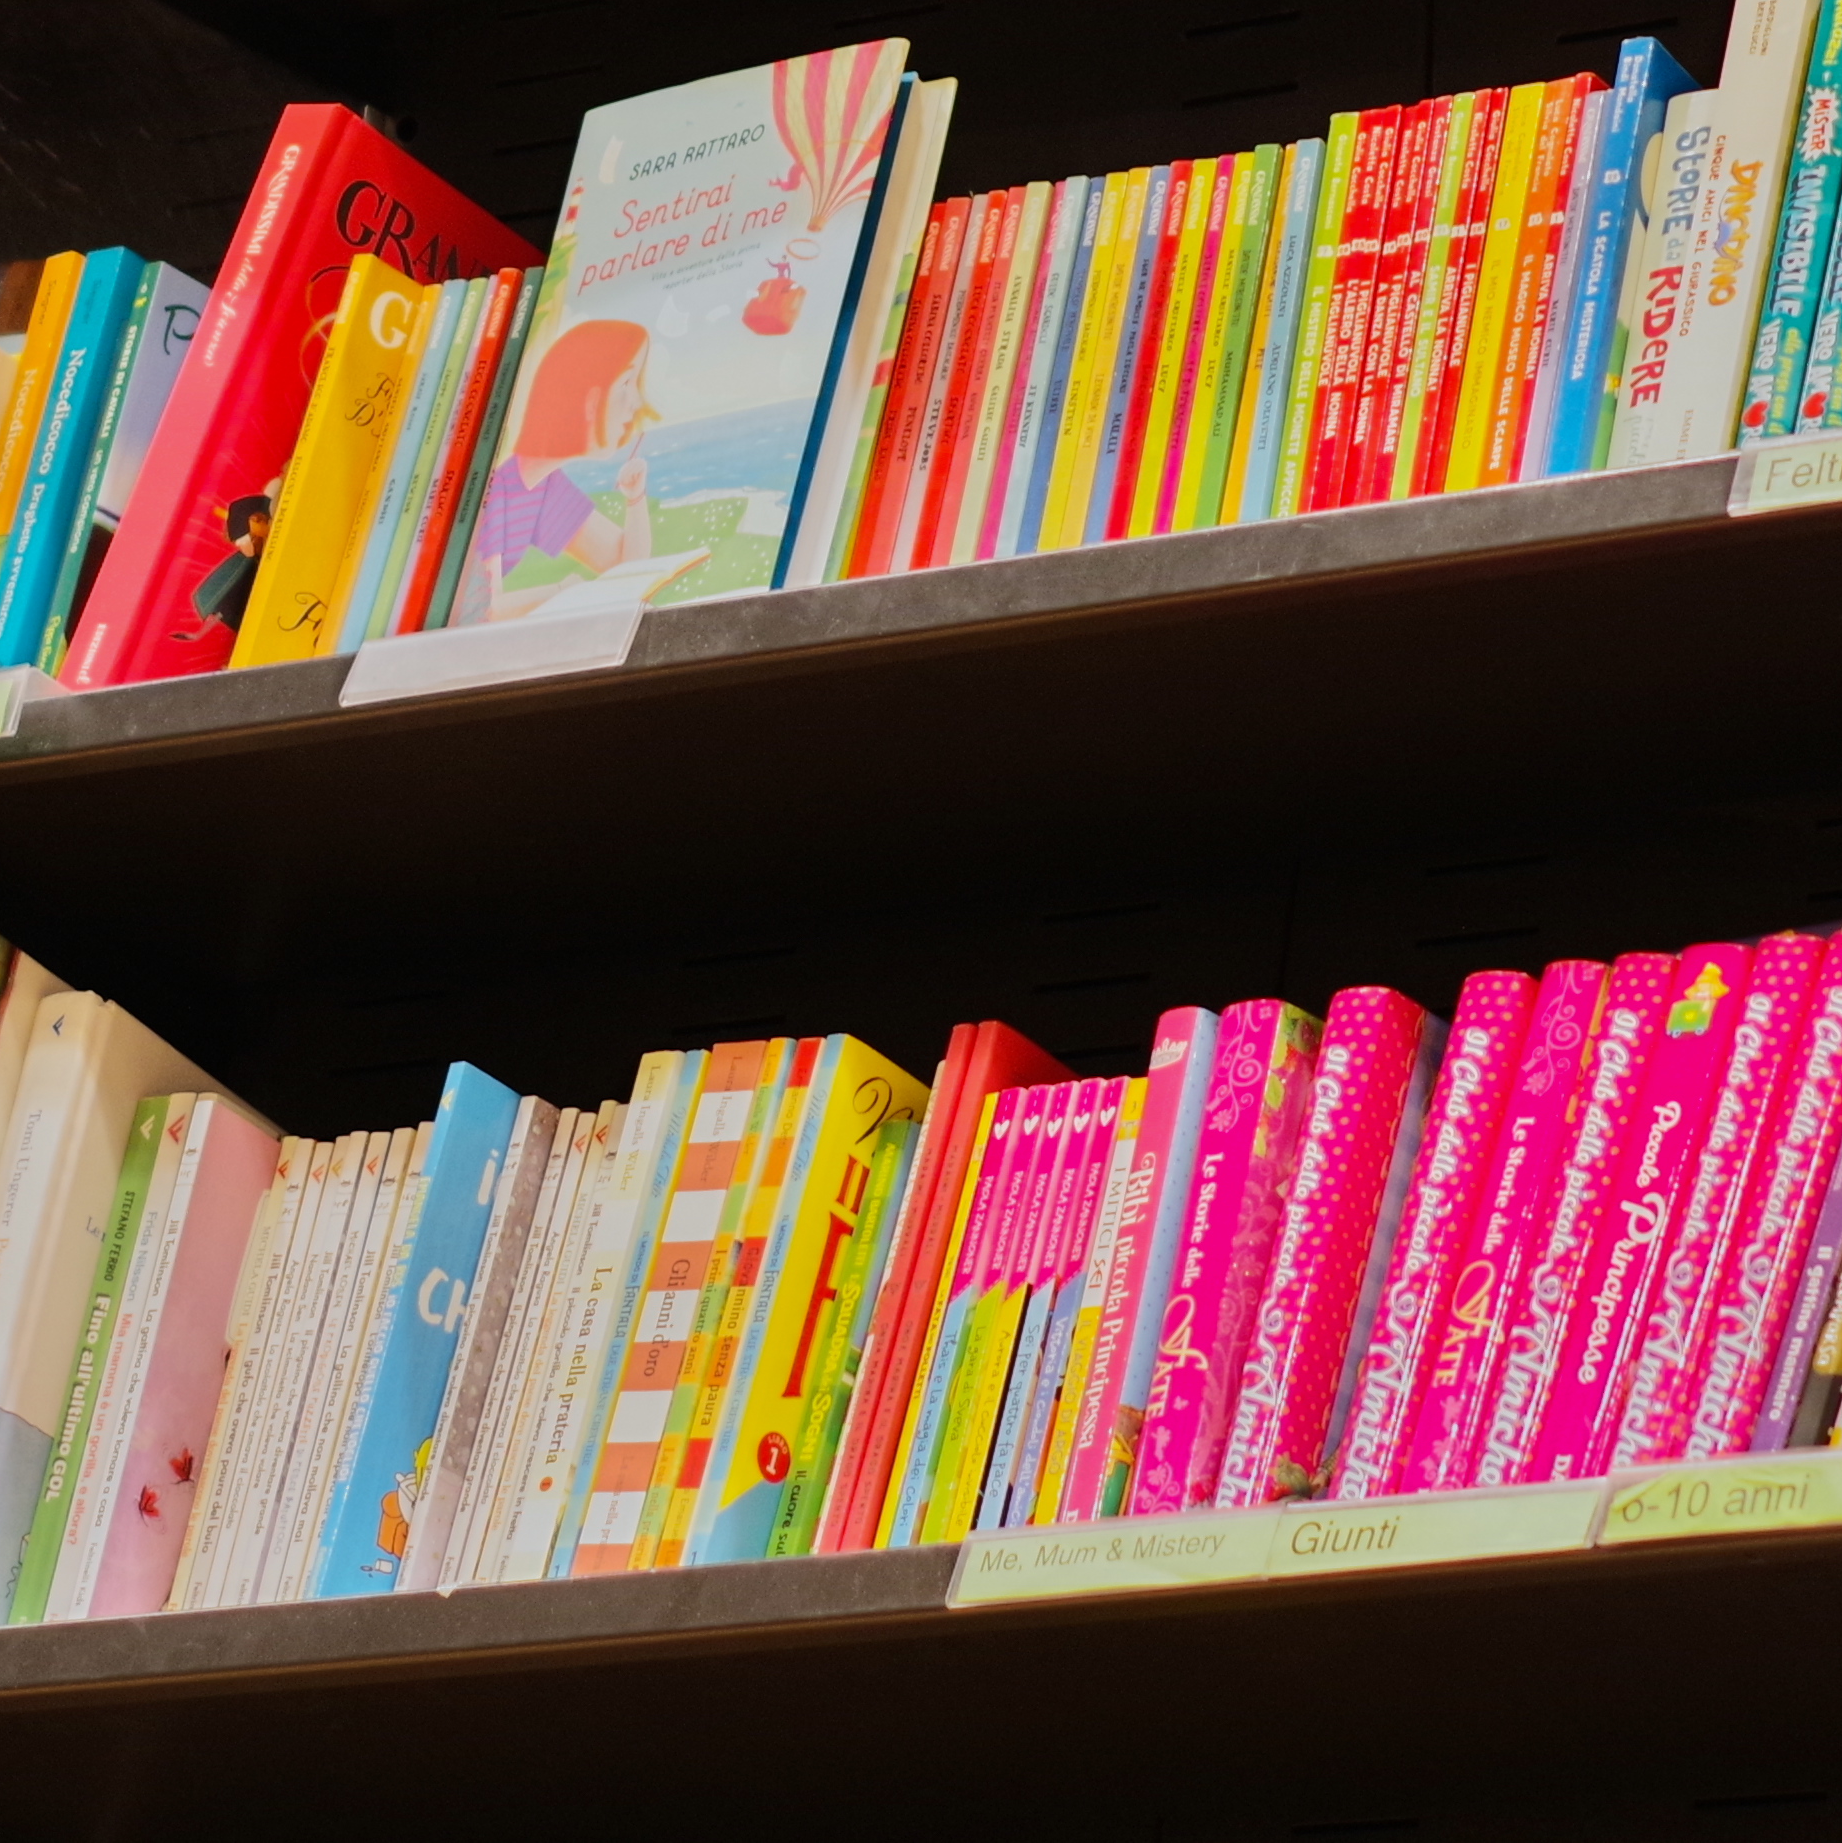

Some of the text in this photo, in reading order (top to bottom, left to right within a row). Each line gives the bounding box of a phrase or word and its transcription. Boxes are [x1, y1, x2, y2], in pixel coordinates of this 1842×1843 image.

[629, 152, 677, 180] SARA
[684, 123, 766, 166] RATTARO
[579, 198, 787, 296] parlare di me
[614, 175, 737, 238] Sentirai
[1680, 135, 1725, 337] CINQUE AMICI NEL GIURASSICO
[1774, 165, 1827, 317] INVISIBILE
[1571, 211, 1610, 381] LA SCATOLA MISTERIOSA
[40, 348, 86, 476] Nocedicocco
[18, 483, 45, 551] Draghetto
[1636, 1102, 1682, 1187] Piccole
[1111, 1228, 1133, 1313] piccola
[1578, 1194, 1666, 1384] Principesse
[86, 1294, 111, 1344] Fino
[59, 1350, 94, 1456] all'ultimo
[545, 1266, 614, 1464] La casa nella prateria
[1078, 1318, 1122, 1449] Principessa
[1289, 1516, 1396, 1557] Giunti
[1723, 1476, 1809, 1514] anni
[980, 1530, 1225, 1574] Me, Mum & Mistery
